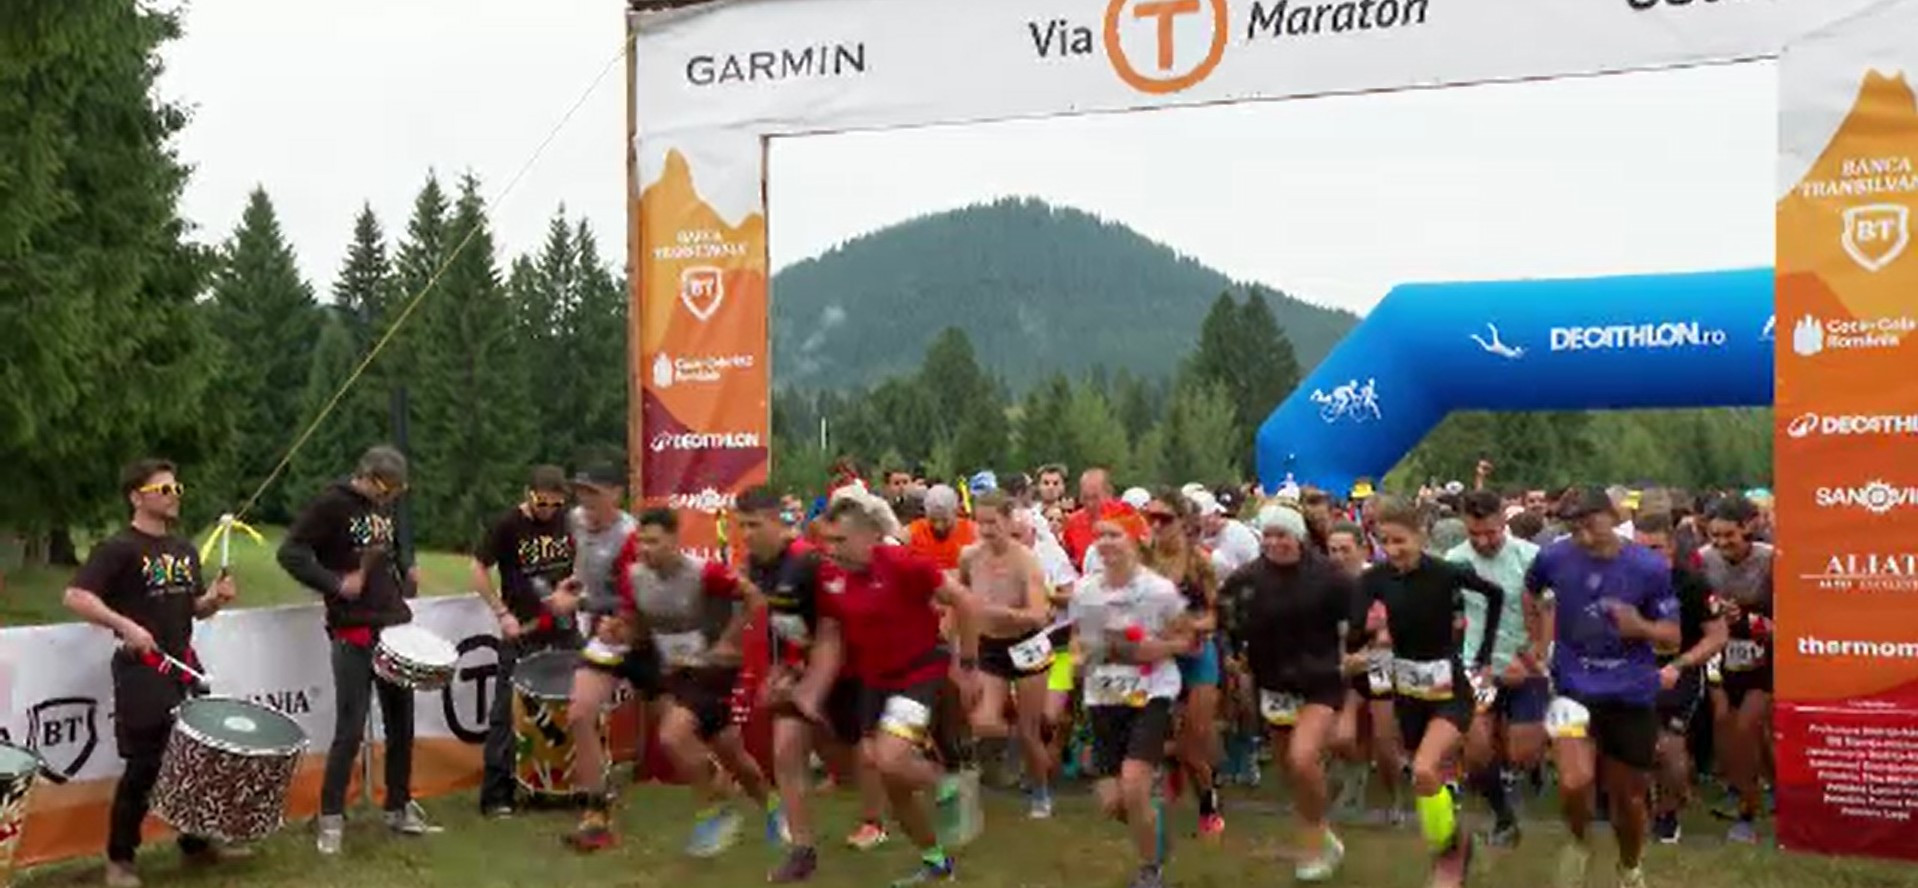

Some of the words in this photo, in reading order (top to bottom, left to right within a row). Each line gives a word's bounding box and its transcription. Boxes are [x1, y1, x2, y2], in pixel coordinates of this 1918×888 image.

[1028, 20, 1093, 58] Via
[1246, 0, 1430, 40] Maraton
[685, 42, 865, 86] GARMIN
[1842, 157, 1912, 178] BANCA
[1857, 219, 1896, 241] BT
[1823, 553, 1918, 577] ALIAT
[43, 716, 84, 747] BT
